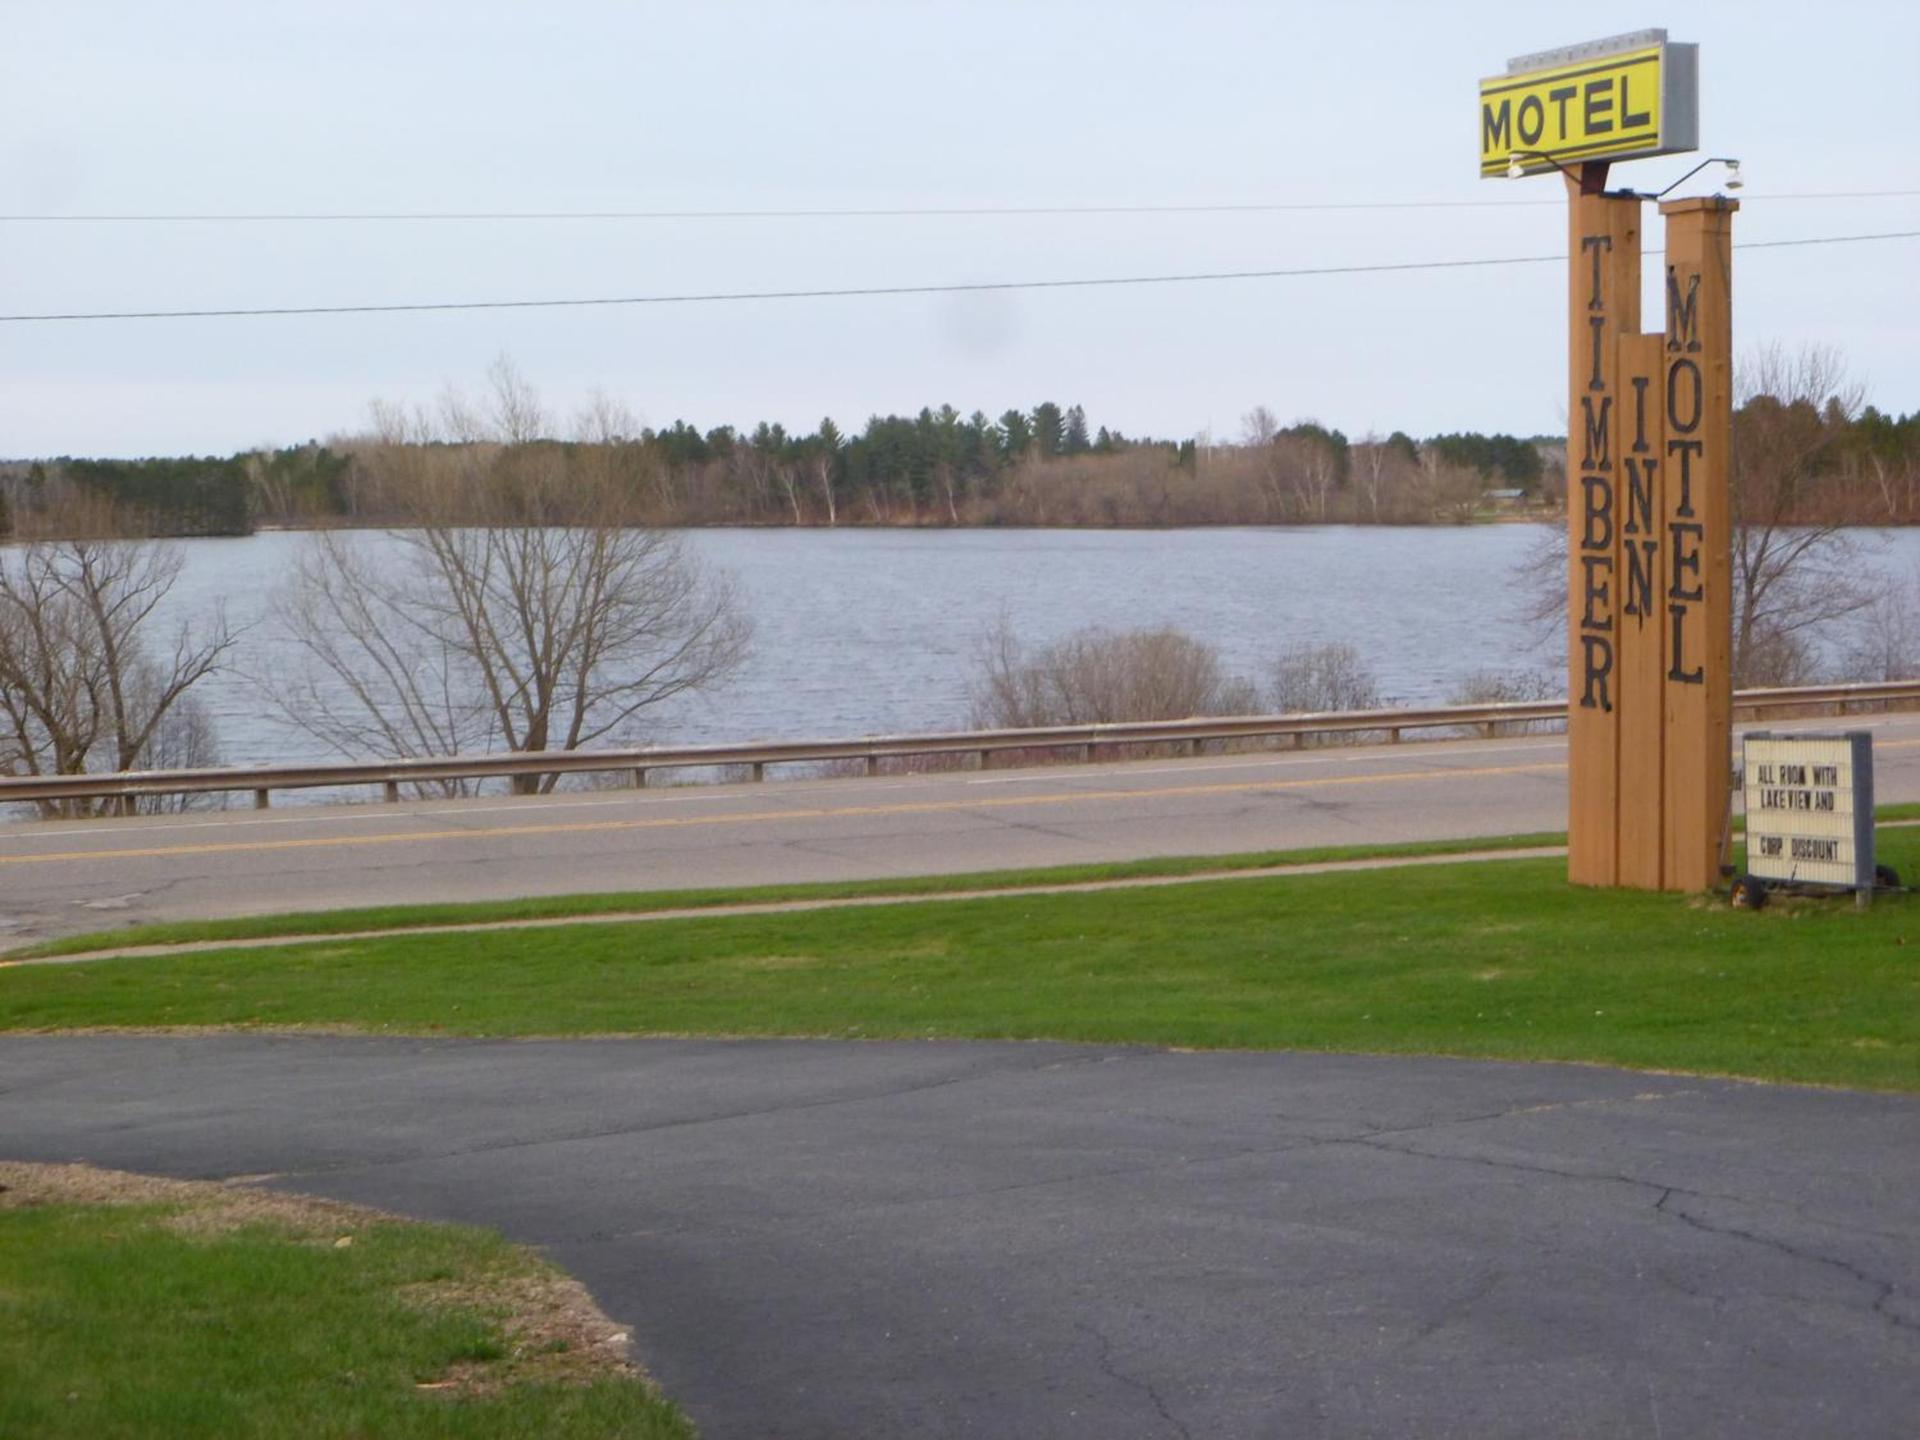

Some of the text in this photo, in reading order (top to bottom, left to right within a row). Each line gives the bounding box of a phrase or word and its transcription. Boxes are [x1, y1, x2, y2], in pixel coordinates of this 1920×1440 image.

[1483, 75, 1650, 153] MOTEL
[1581, 235, 1612, 713] TIMBER
[1624, 377, 1657, 618] INN
[1667, 266, 1703, 685] MOTEL
[1758, 764, 1838, 786] ALL ROOM WITH
[1761, 789, 1834, 811] LAKE VIEW AND
[1791, 838, 1839, 860] DISCOUNT
